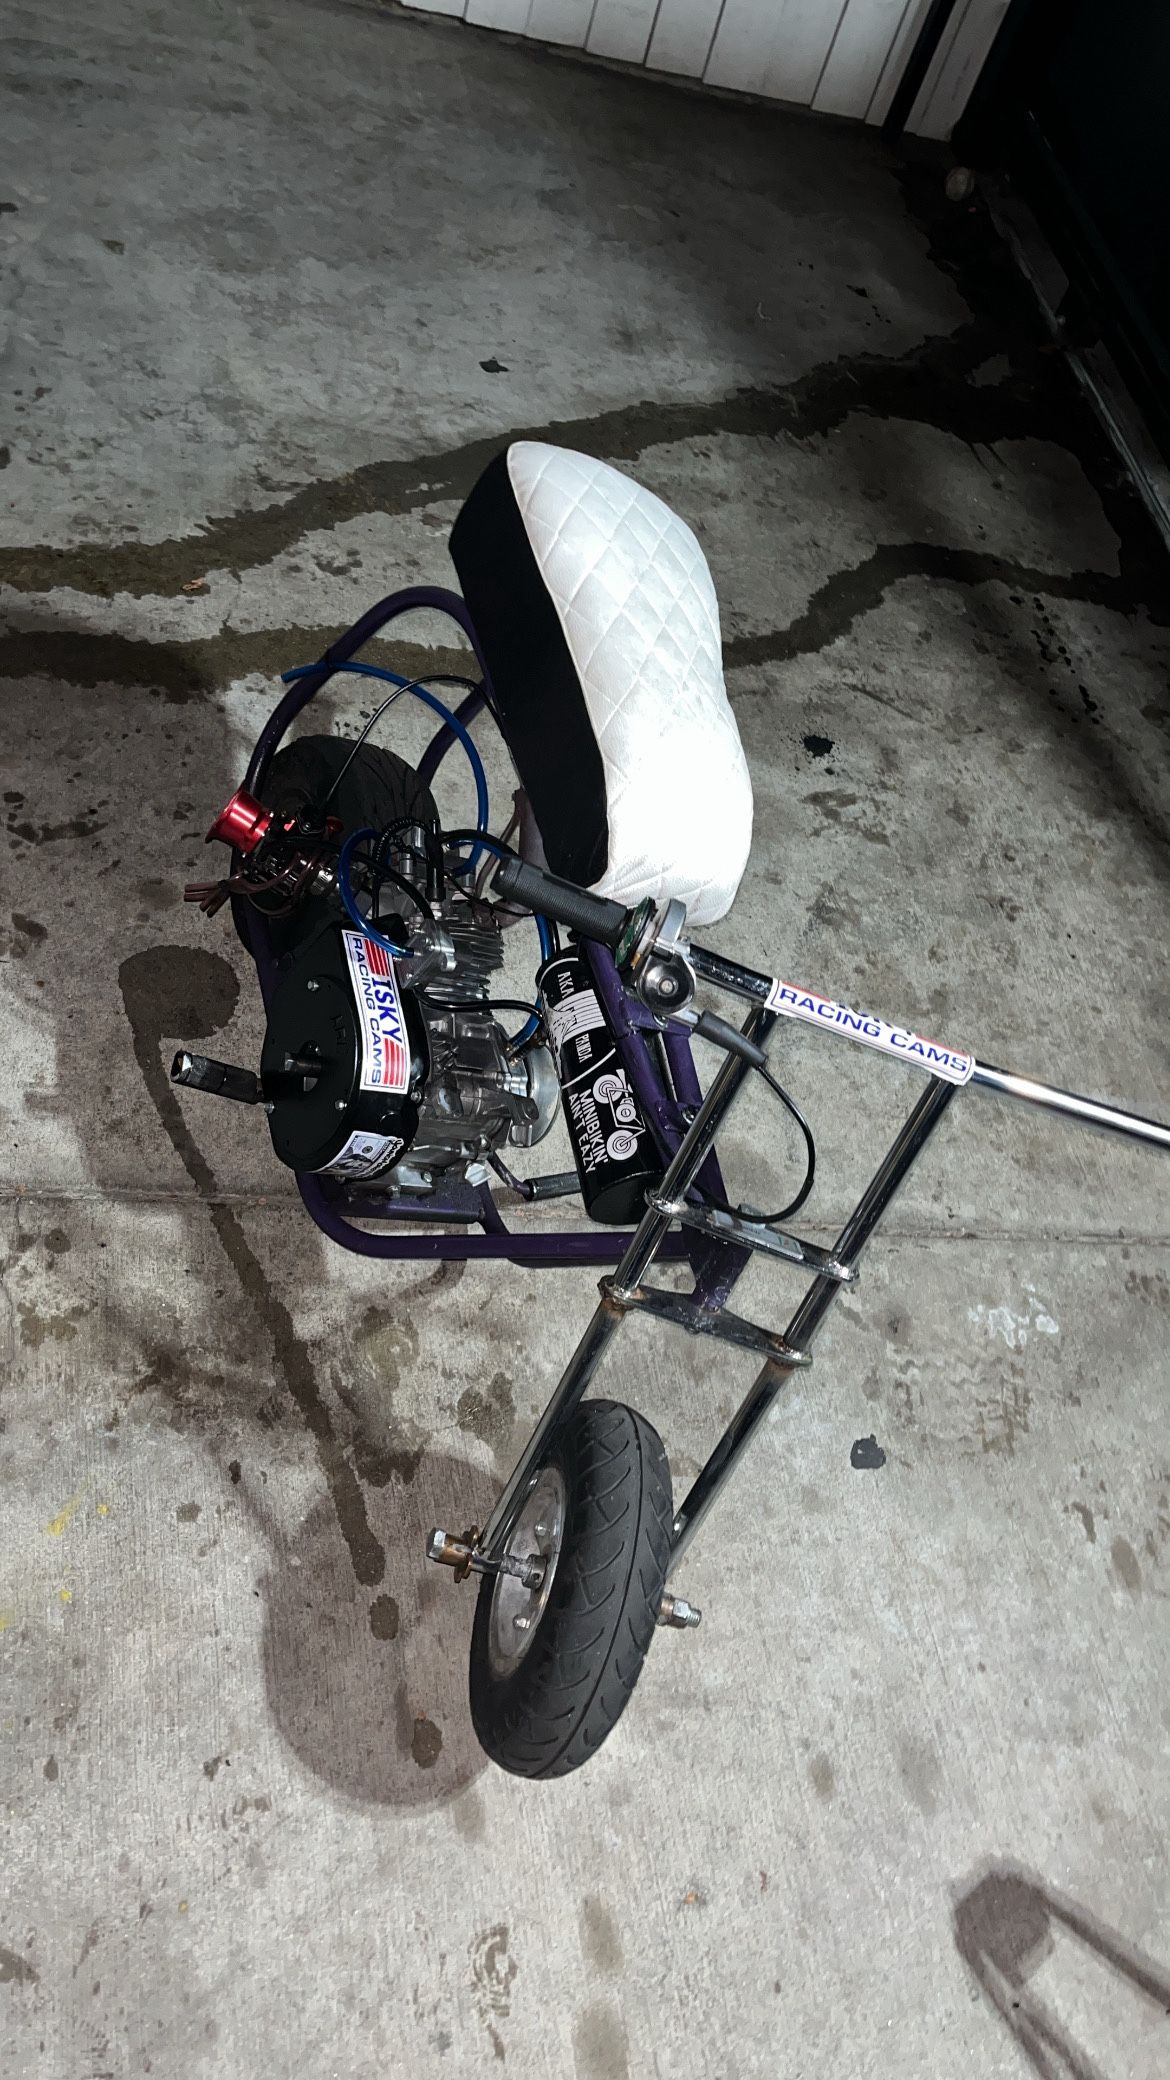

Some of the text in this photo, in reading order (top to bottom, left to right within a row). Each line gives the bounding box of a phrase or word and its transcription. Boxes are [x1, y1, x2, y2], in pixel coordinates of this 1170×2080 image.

[352, 937, 383, 1084] RACING CAMS
[372, 976, 403, 1043] ISKY
[557, 971, 575, 999] AKA
[575, 1033, 593, 1064] PANDA
[779, 988, 881, 1038] RACING
[890, 1033, 967, 1073] CAMS
[568, 1092, 596, 1174] AIN'T EAZY
[579, 1088, 609, 1164] MINIBIKIN'
